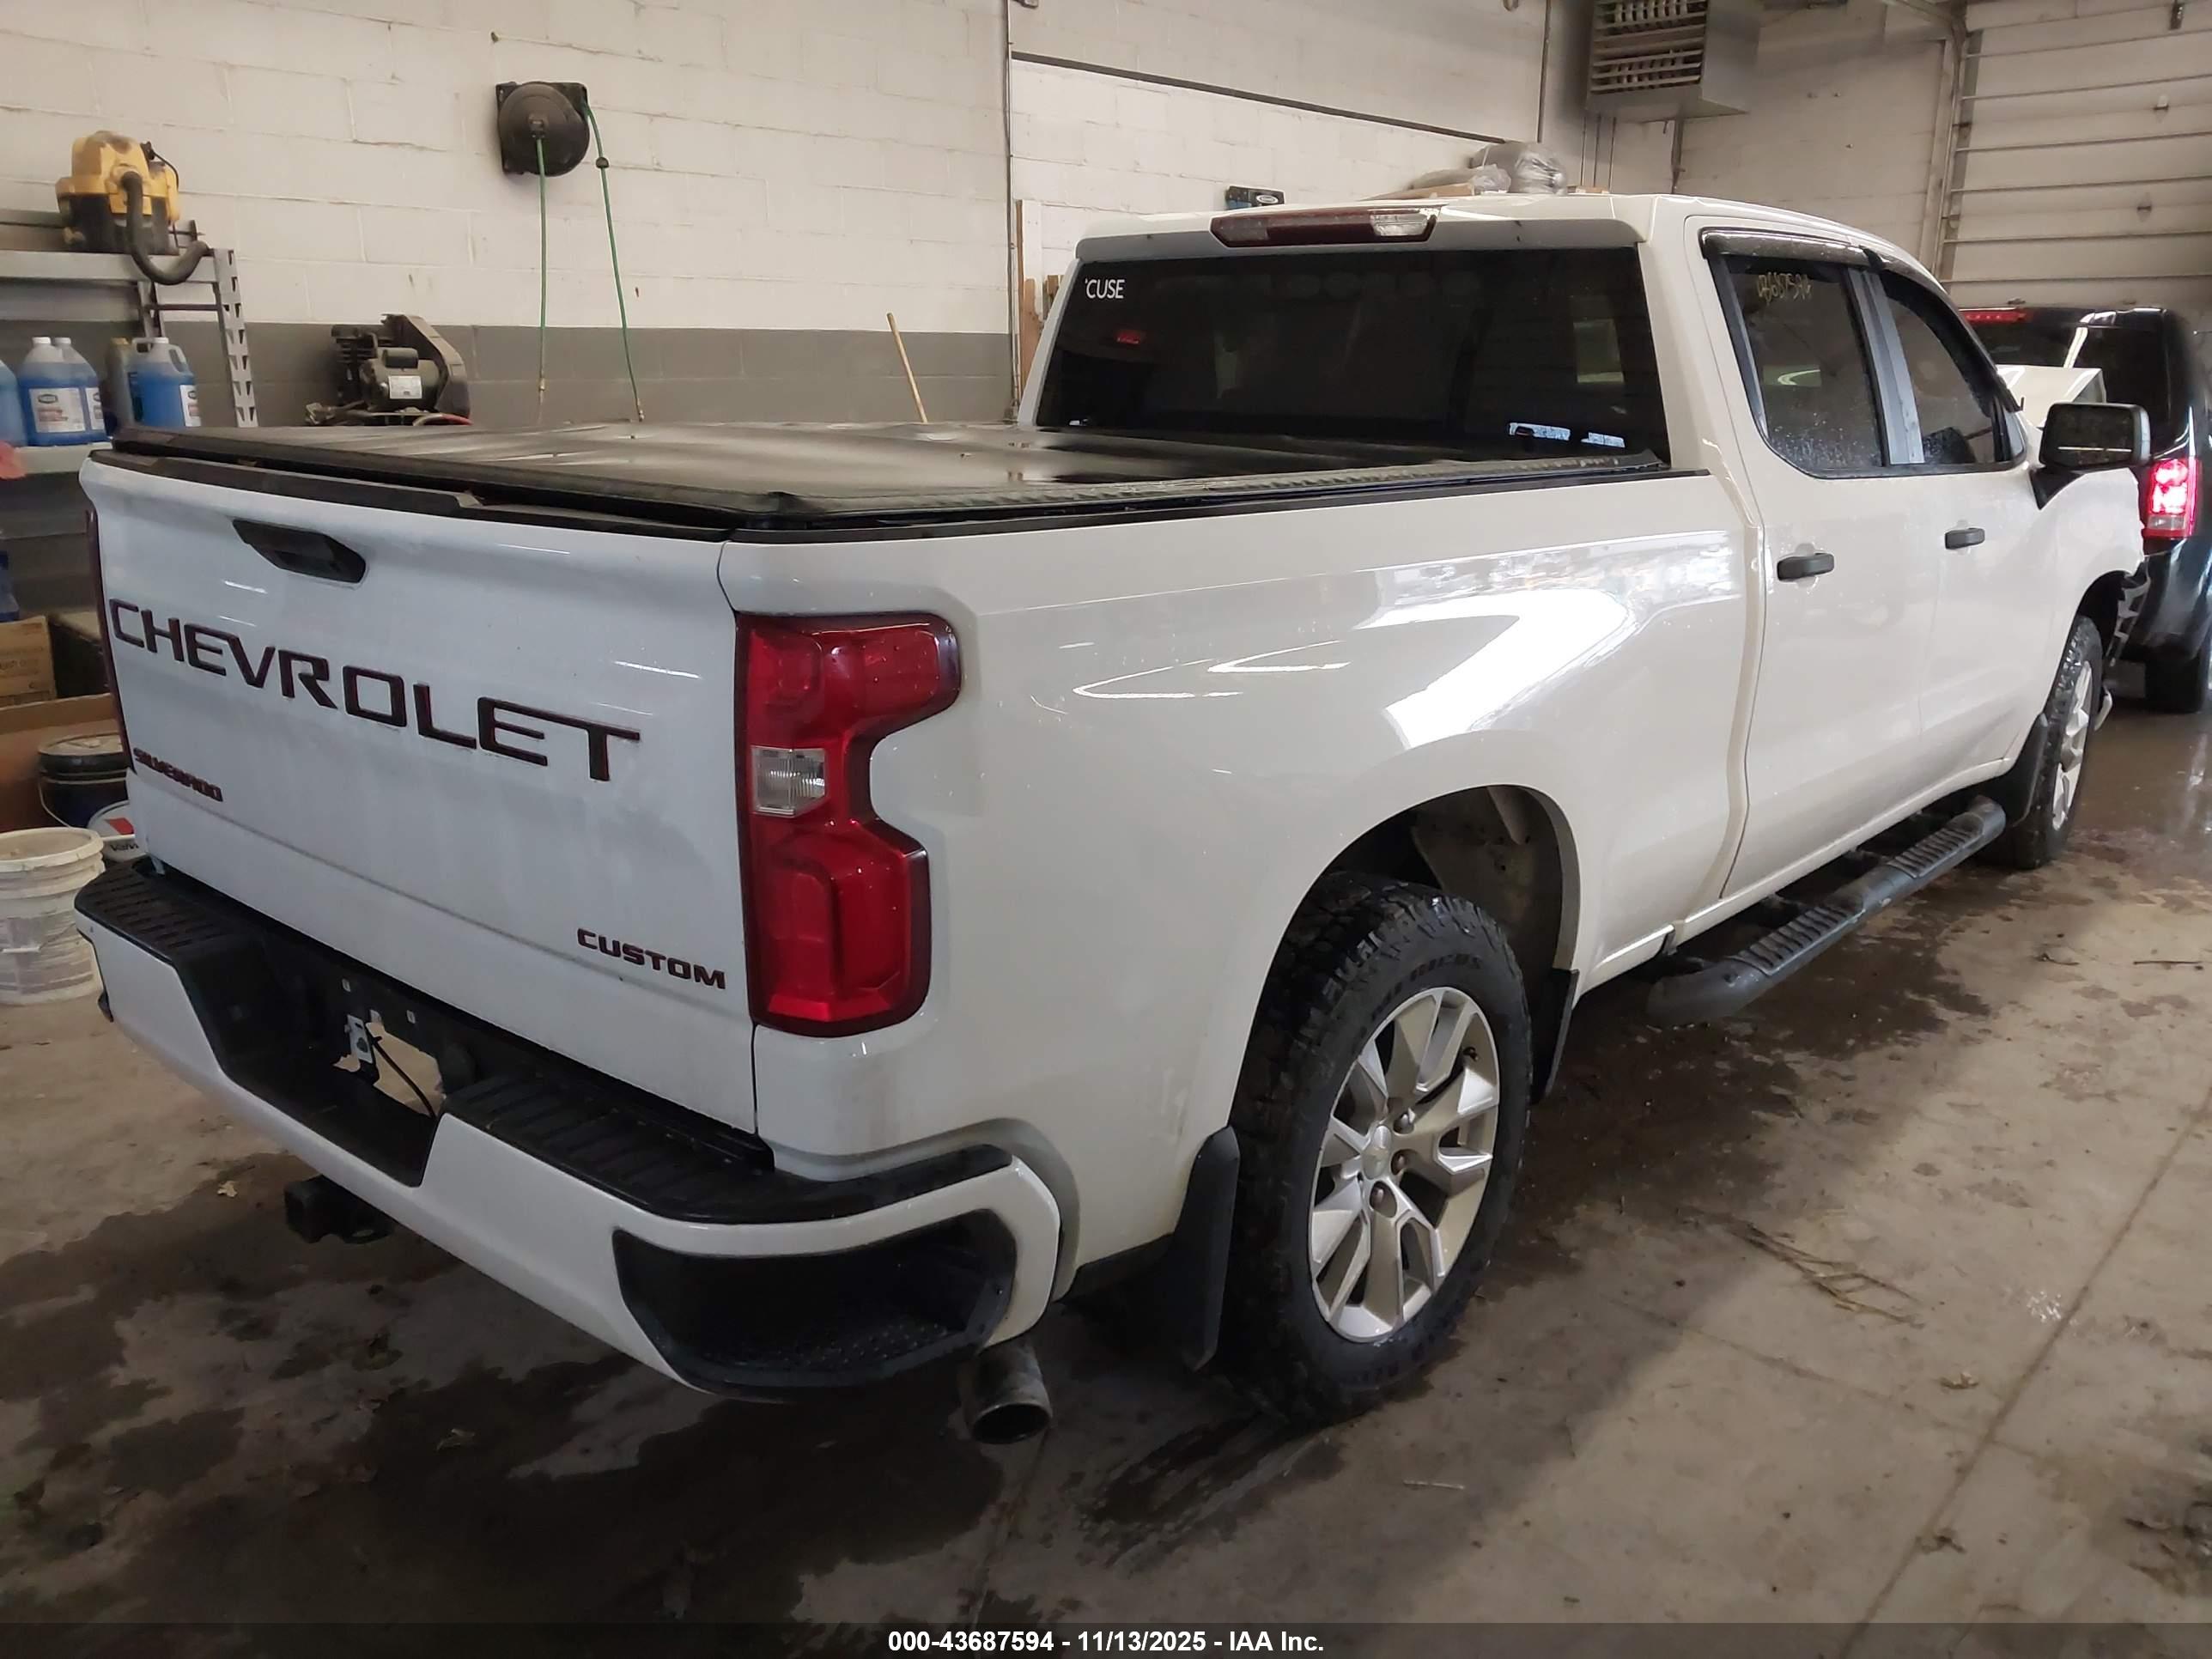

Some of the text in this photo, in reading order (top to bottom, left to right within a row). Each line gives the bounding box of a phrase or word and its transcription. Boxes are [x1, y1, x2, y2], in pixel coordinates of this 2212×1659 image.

[1085, 277, 1126, 299] 'CUSE
[109, 598, 641, 781] CHEVROLET
[577, 927, 726, 990] CUSTOM
